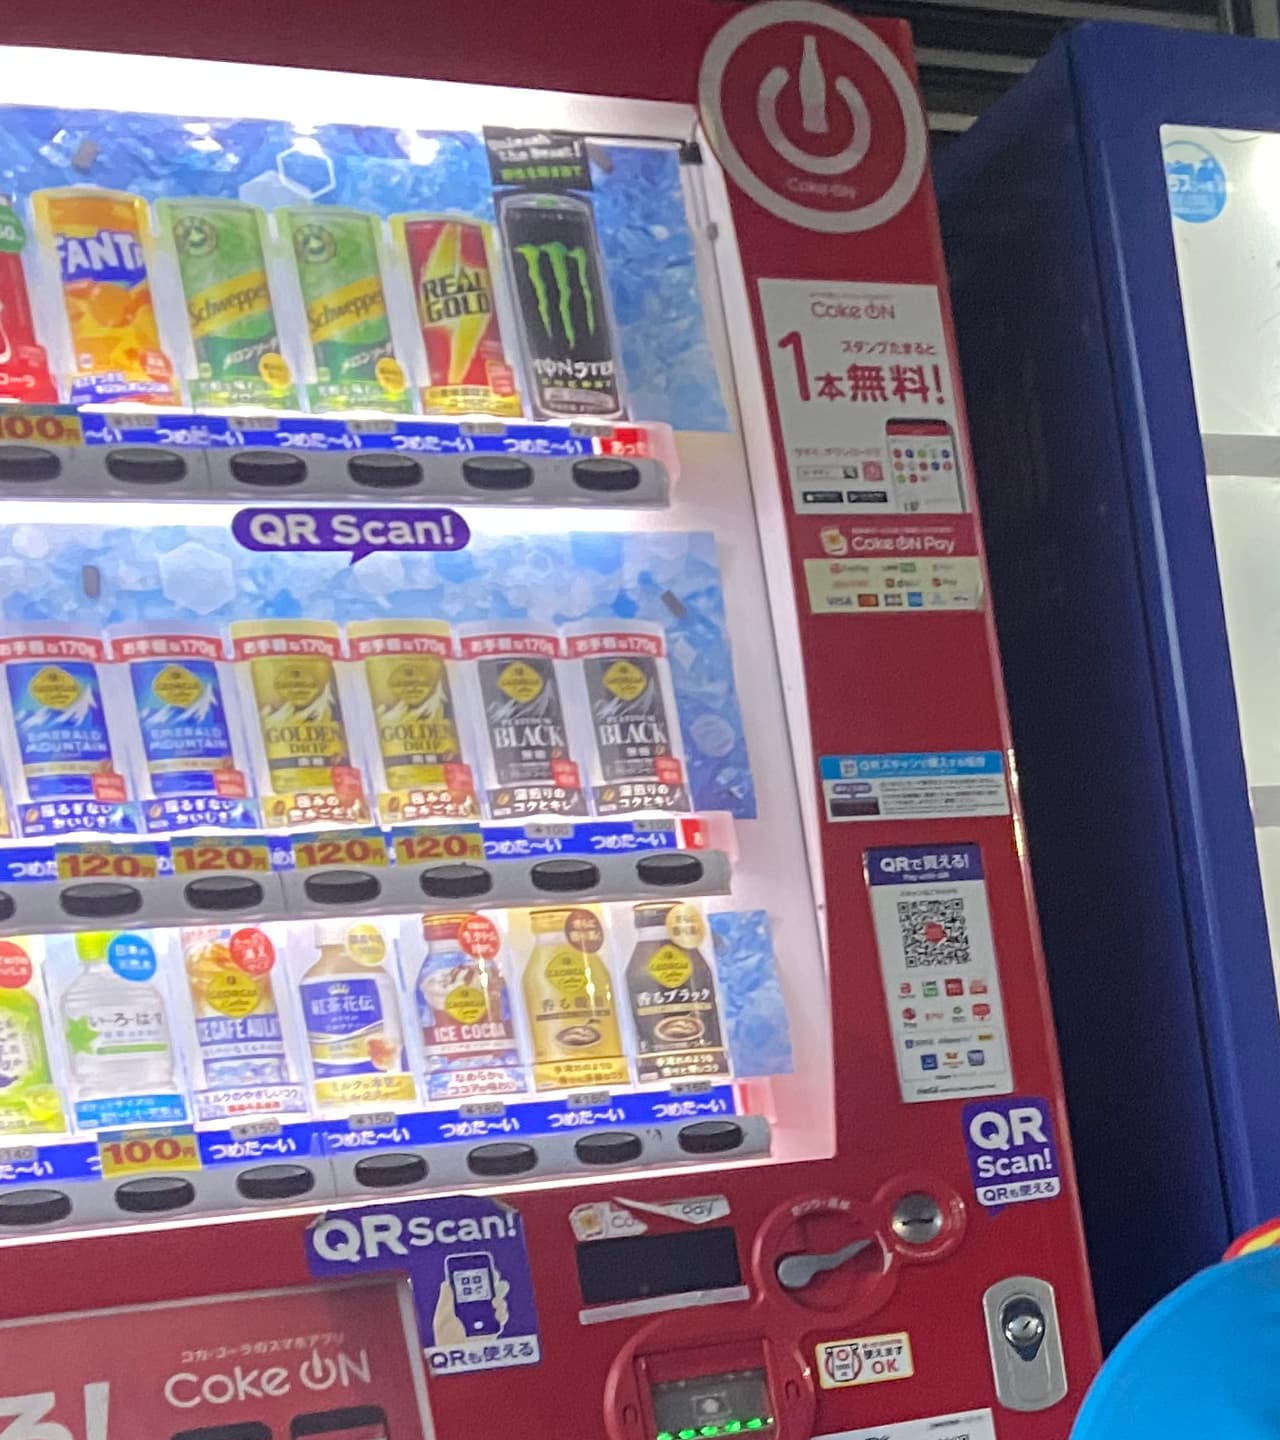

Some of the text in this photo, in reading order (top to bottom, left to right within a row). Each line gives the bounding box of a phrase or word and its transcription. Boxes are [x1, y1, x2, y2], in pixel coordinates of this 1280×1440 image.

[422, 268, 482, 299] REAL
[426, 292, 491, 324] GOLD
[811, 301, 862, 319] Coke
[249, 510, 455, 548] QR Scan!
[493, 724, 565, 748] BLACK
[599, 722, 667, 745] BLACK
[637, 987, 712, 1006] 香るブラック
[434, 1027, 457, 1043] ICE
[547, 1107, 626, 1129] つめた〜い
[652, 1098, 727, 1118] つめた〜い
[327, 1127, 411, 1149] つめた〜い
[439, 1116, 521, 1139] つめた〜い
[969, 1107, 1048, 1151] QR
[209, 1138, 297, 1161] つめた〜い
[976, 1148, 1053, 1179] Scan!
[983, 1181, 1055, 1202] QRも使える
[312, 1207, 518, 1262] QR Scan!
[429, 1340, 536, 1371] QRも使える
[871, 1359, 900, 1375] OK
[163, 1347, 372, 1409] Coke ON
